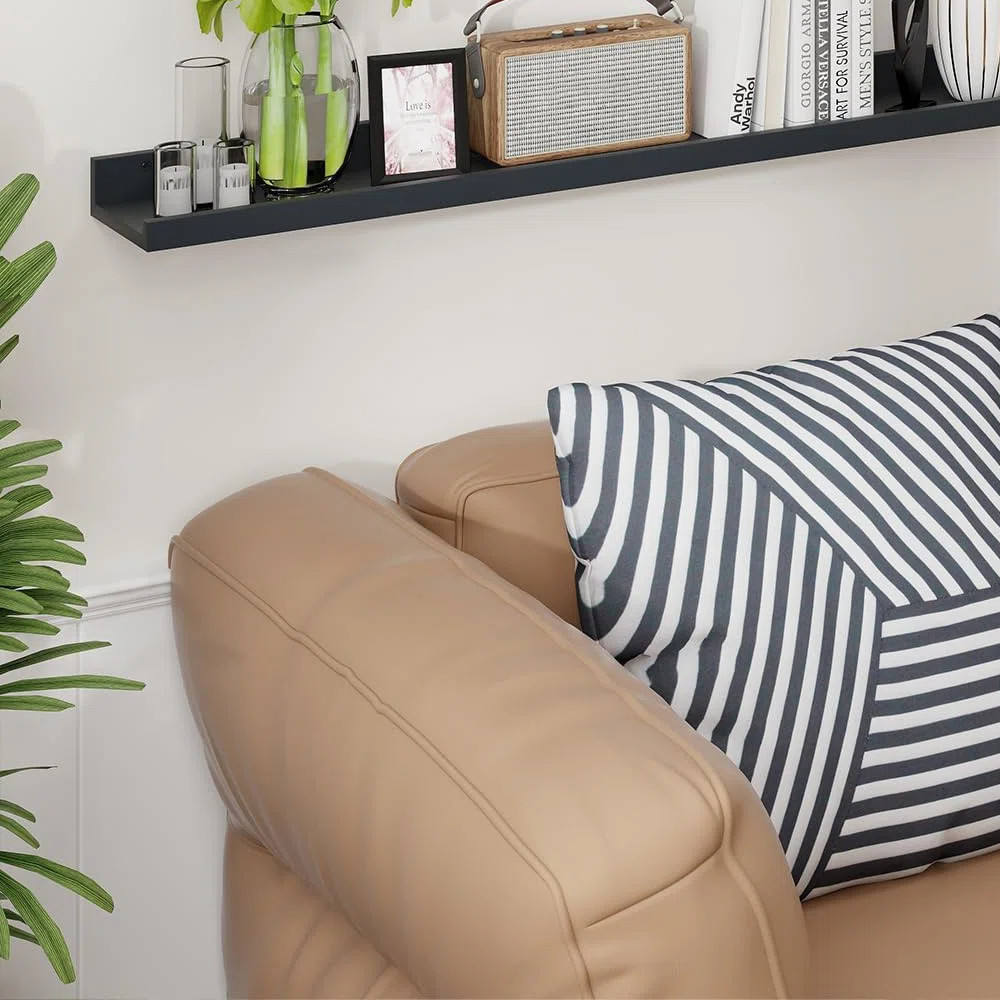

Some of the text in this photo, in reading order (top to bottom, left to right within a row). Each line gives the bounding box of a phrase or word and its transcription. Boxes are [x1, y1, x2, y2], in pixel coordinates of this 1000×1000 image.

[859, 8, 872, 57] STYLE
[801, 43, 811, 108] GIORGIO
[818, 49, 829, 120] VERSACE
[836, 10, 849, 120] ART FOR SURVIVAL
[859, 60, 872, 110] MEN'S
[405, 99, 432, 111] Love is
[730, 83, 748, 125] Andy
[741, 77, 755, 131] Warhol
